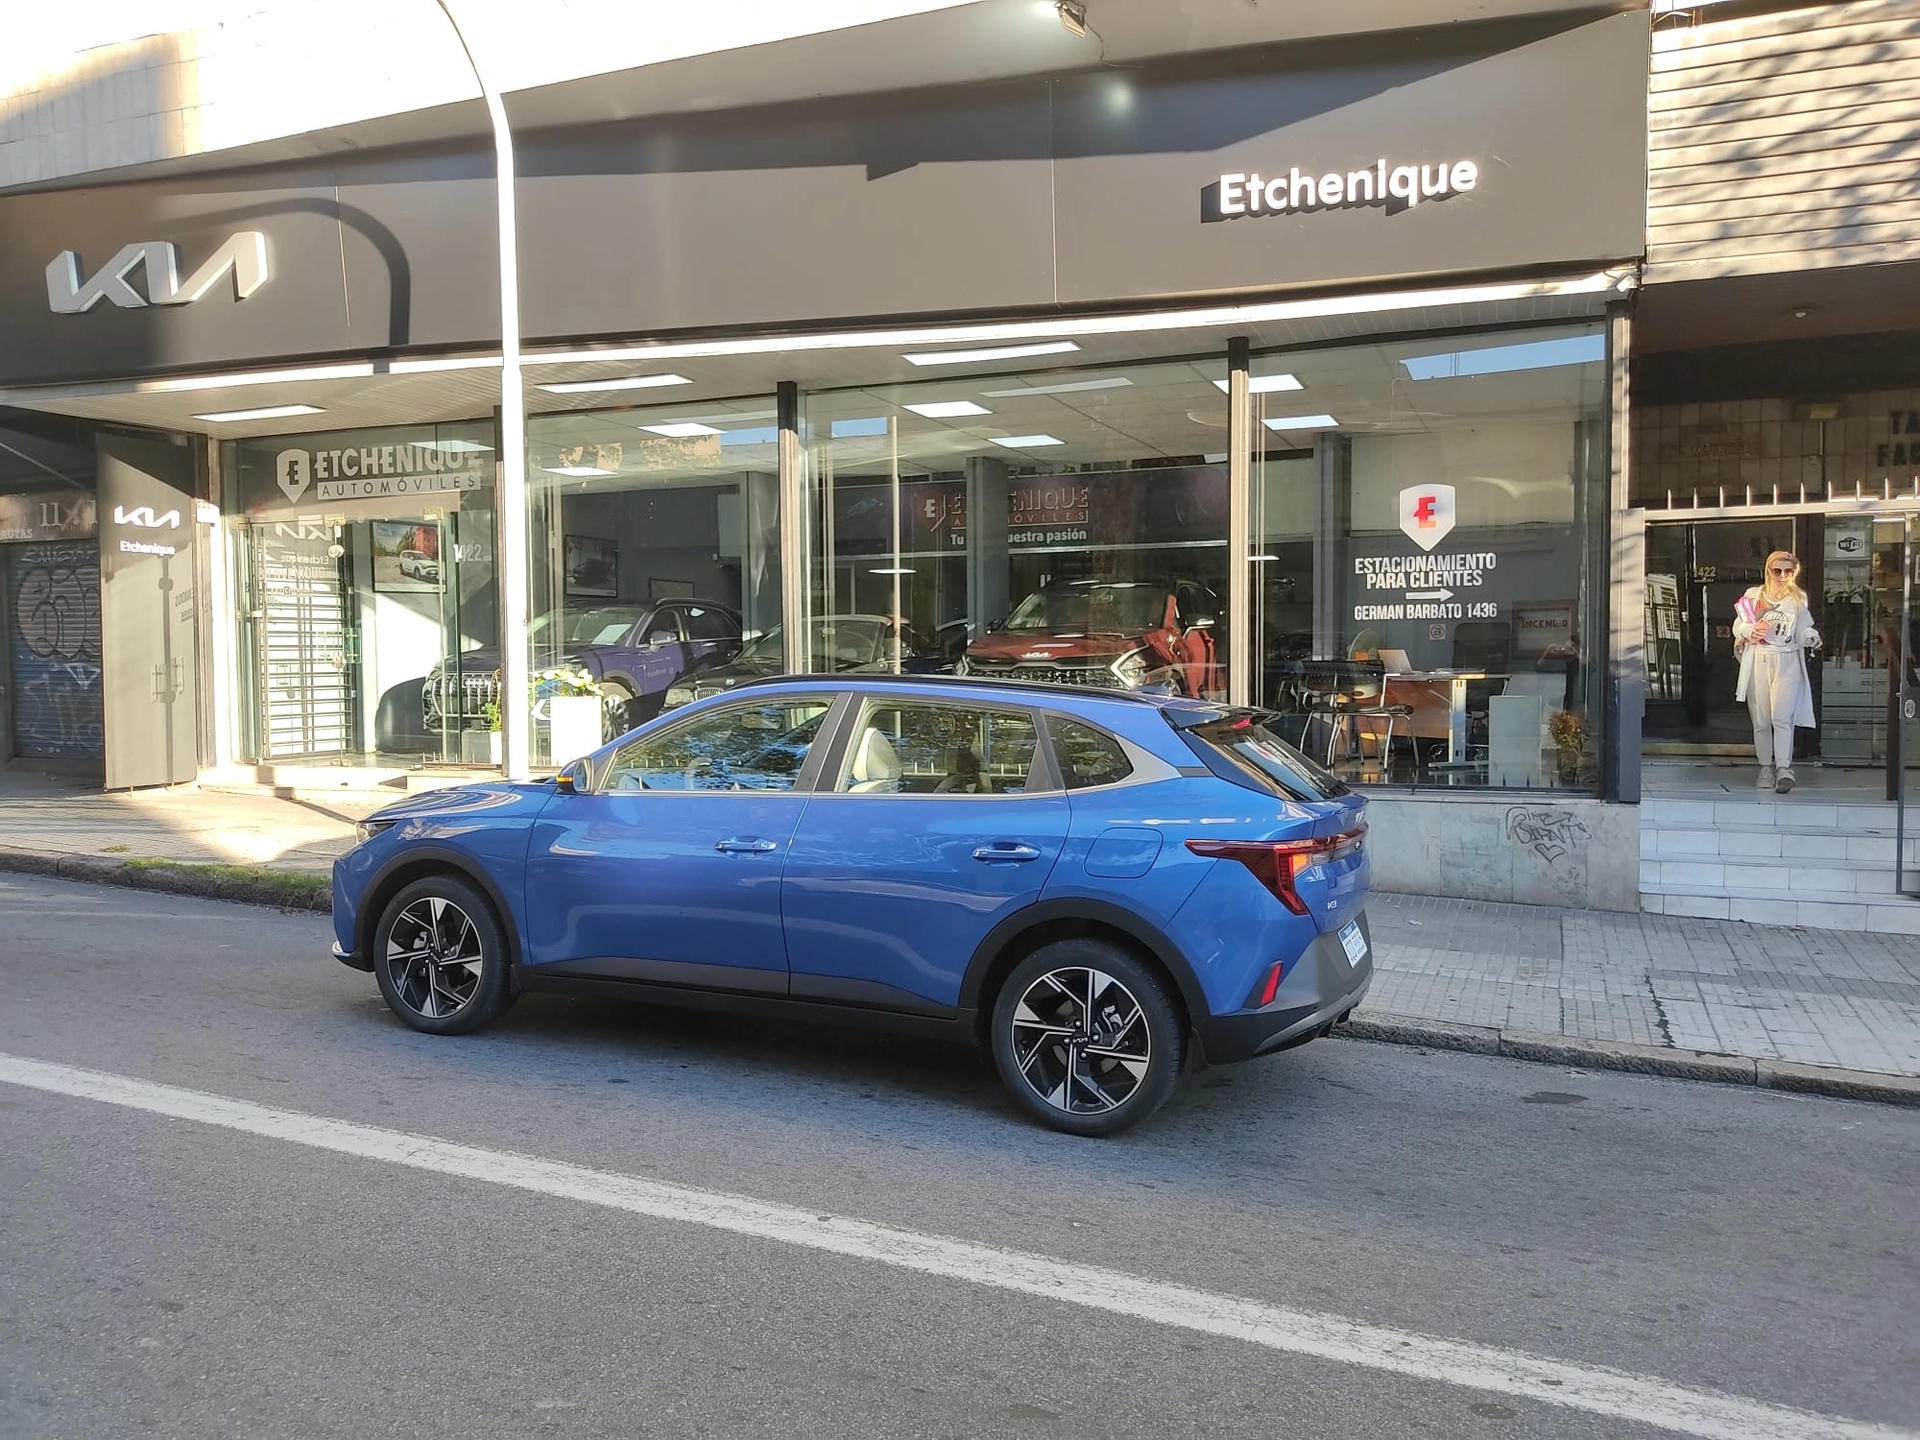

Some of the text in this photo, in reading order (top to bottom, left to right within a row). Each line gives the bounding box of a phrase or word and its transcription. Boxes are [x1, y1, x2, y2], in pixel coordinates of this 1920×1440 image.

[1220, 159, 1478, 214] Etchenique
[46, 231, 268, 314] KIA
[314, 440, 482, 479] ETCHENIQUE
[321, 476, 475, 497] AUTOMÓVILES
[113, 505, 181, 530] KIA
[951, 528, 1087, 546] Tu uestra pasión
[120, 540, 176, 557] Etchenique
[1355, 553, 1497, 575] ESTACIONAMIENTO
[1367, 569, 1483, 590] PARA CLIENTES
[1354, 602, 1498, 621] GERMAN BARBATO 1436
